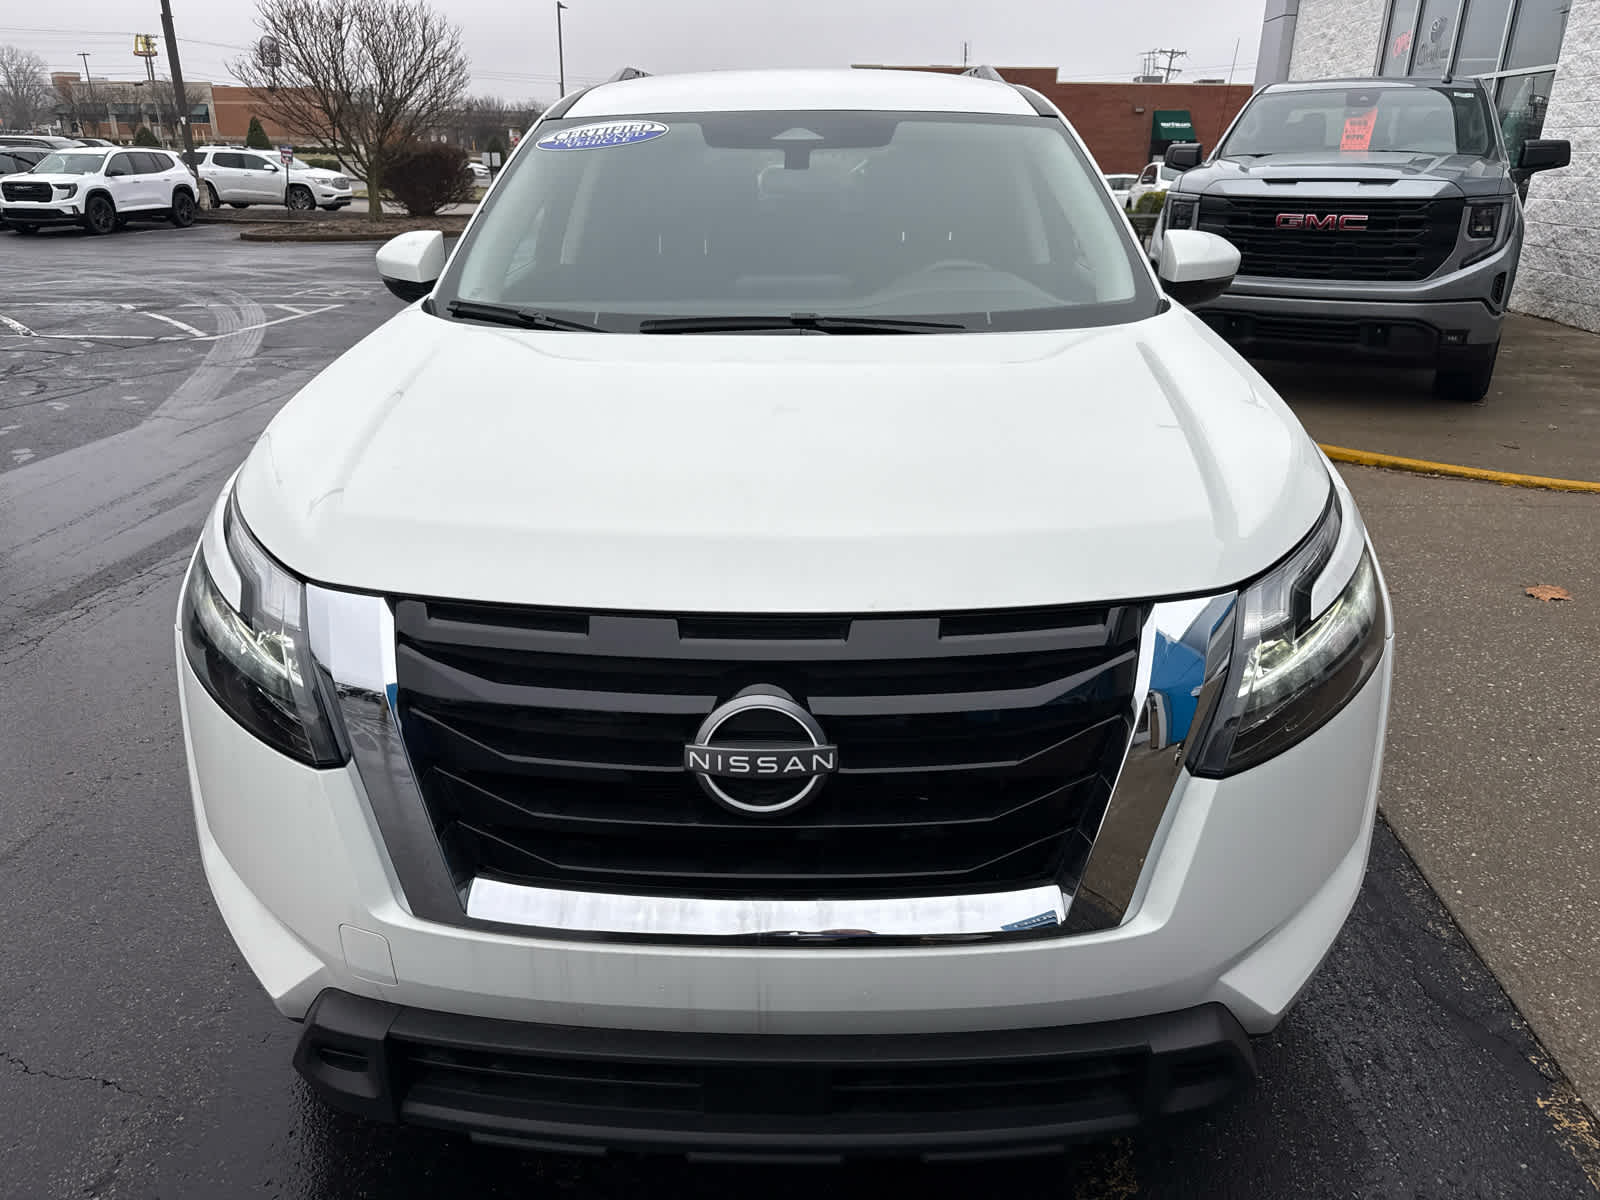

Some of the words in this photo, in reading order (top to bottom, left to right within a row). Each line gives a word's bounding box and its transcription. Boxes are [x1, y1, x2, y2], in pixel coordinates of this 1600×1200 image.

[554, 123, 655, 141] CERTIFIED
[567, 136, 631, 148] VEHICLE
[1275, 213, 1369, 231] GMC
[688, 751, 834, 774] NISSAN
